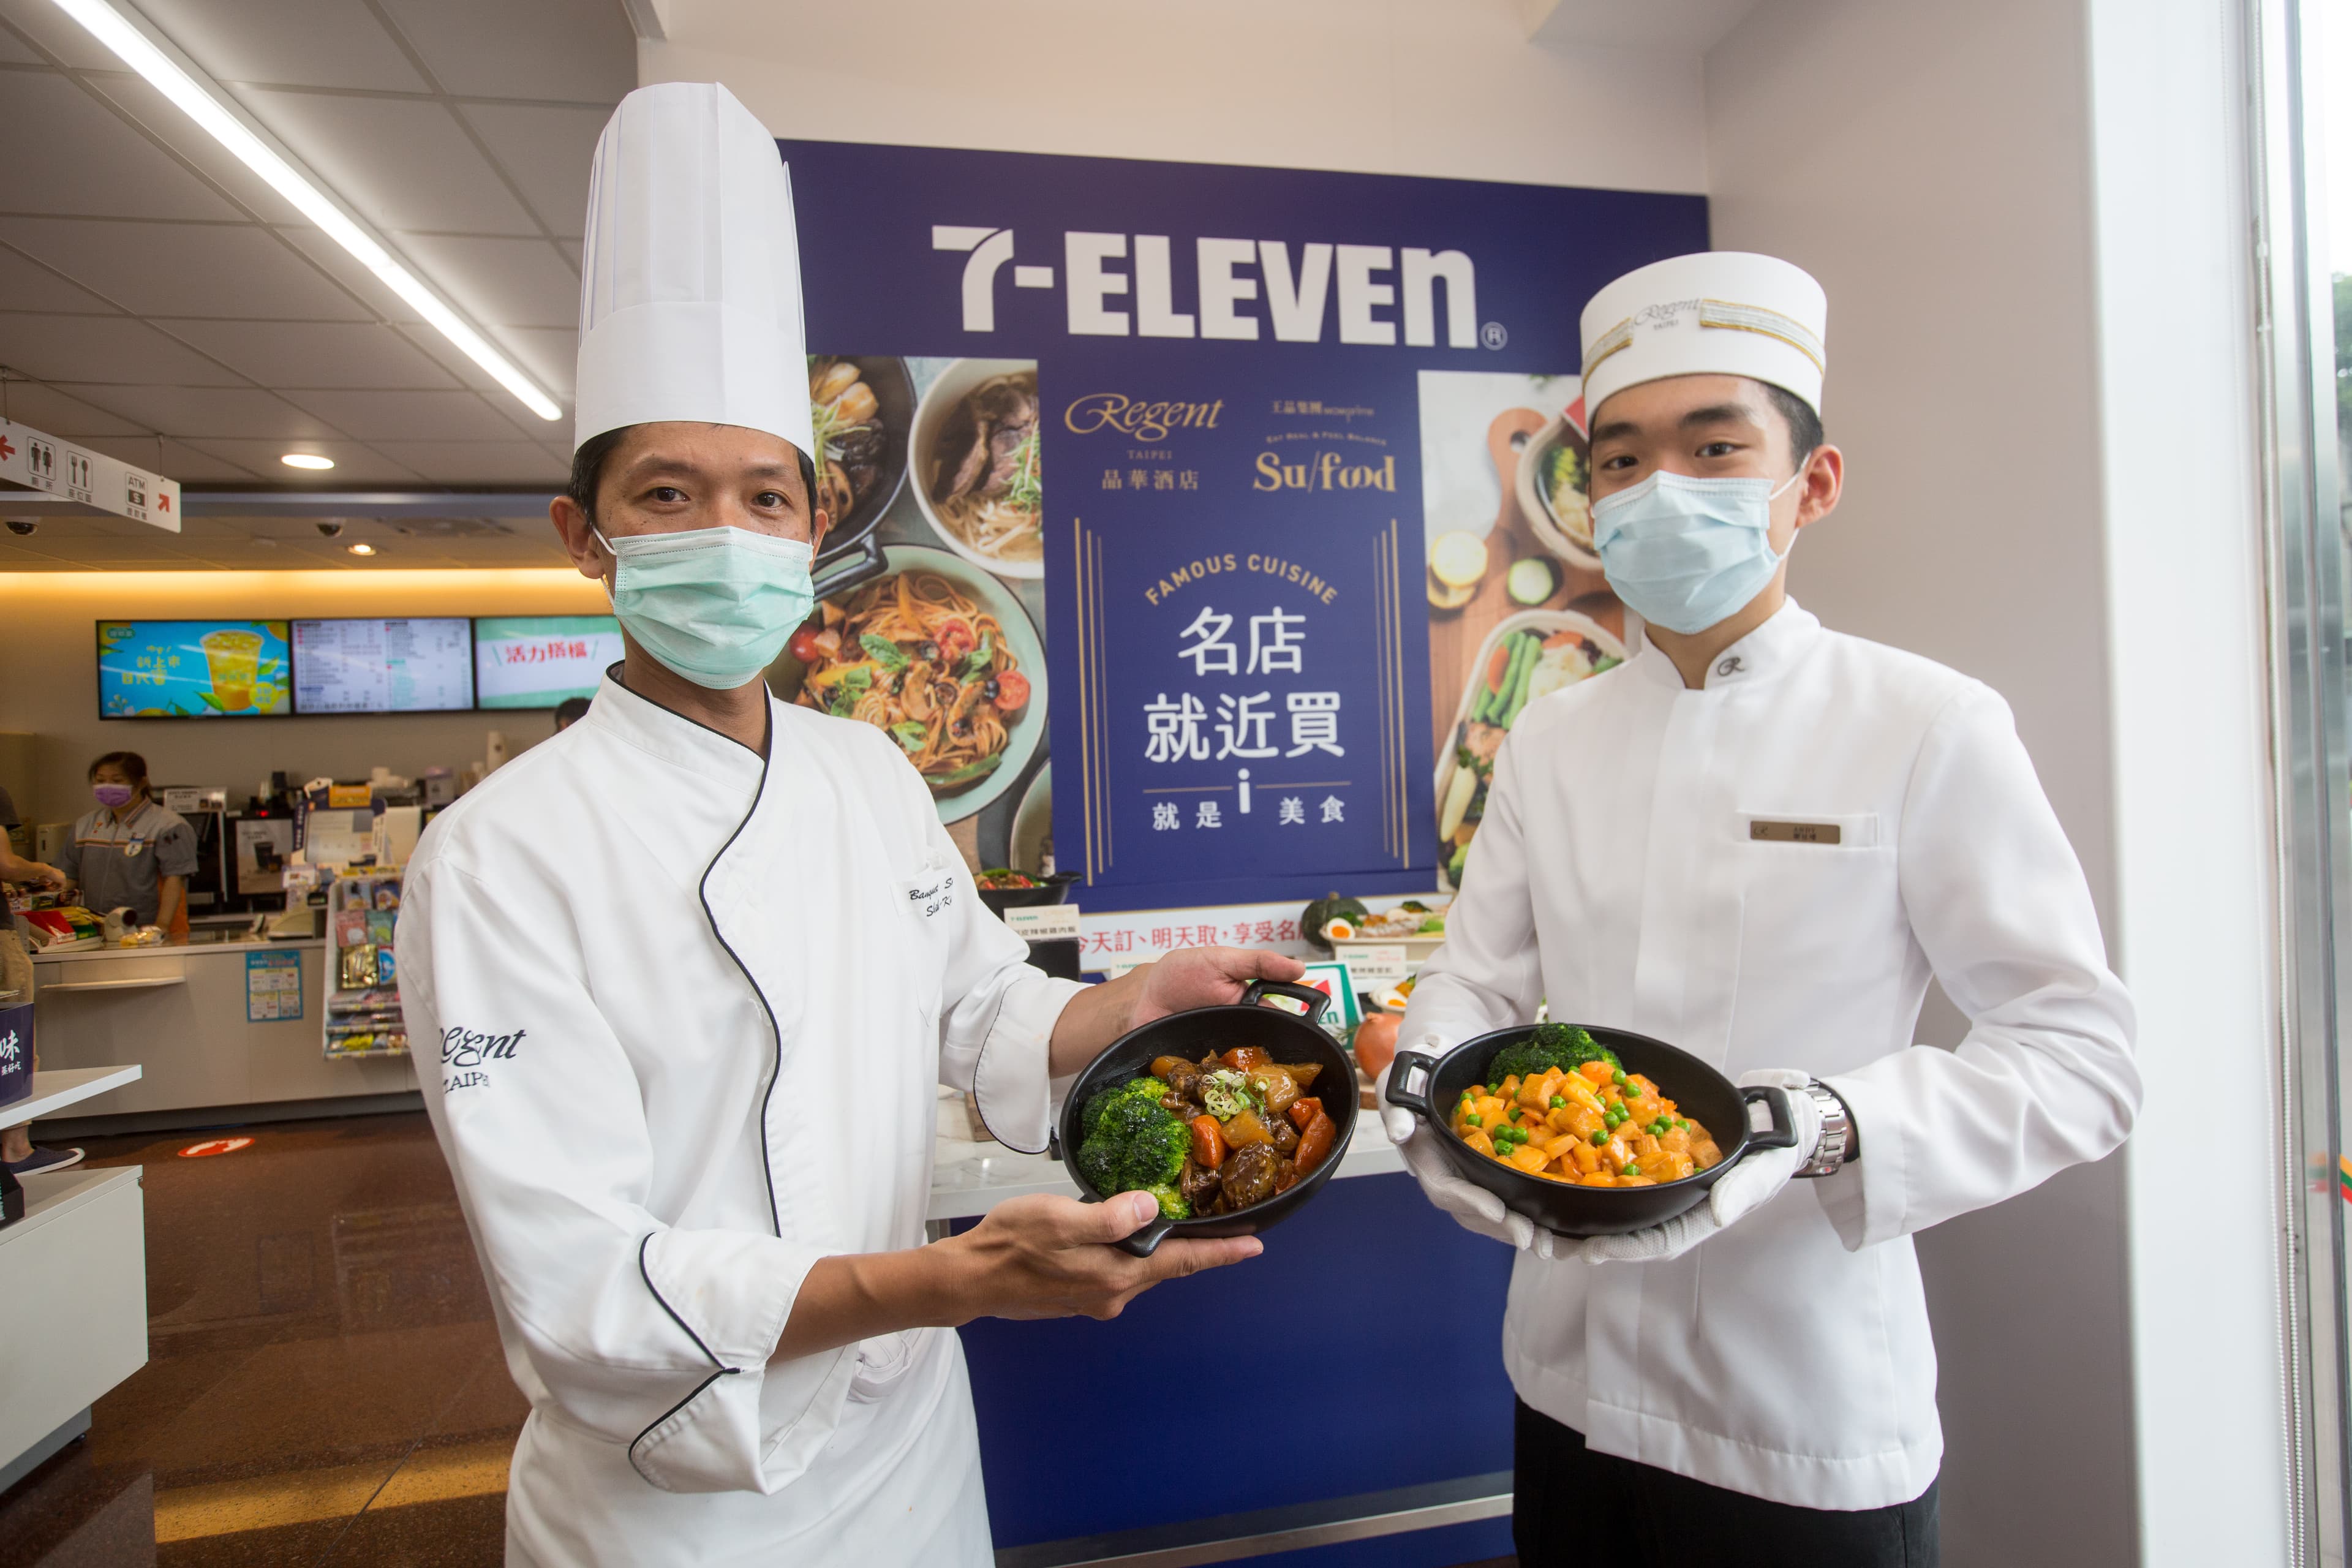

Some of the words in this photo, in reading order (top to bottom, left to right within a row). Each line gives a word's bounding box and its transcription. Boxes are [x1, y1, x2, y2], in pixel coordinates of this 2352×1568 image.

[1065, 392, 1225, 442] Regent
[1126, 450, 1172, 460] TAIPEI
[128, 476, 146, 491] ATM
[1101, 469, 1199, 490] 晶華酒店
[1145, 554, 1237, 606] FAMOUS
[1247, 554, 1338, 605] CUISINE
[1178, 606, 1306, 677] 名店
[1143, 691, 1345, 763] 就近買
[1152, 801, 1223, 831] 就是
[1279, 794, 1344, 826] 美食
